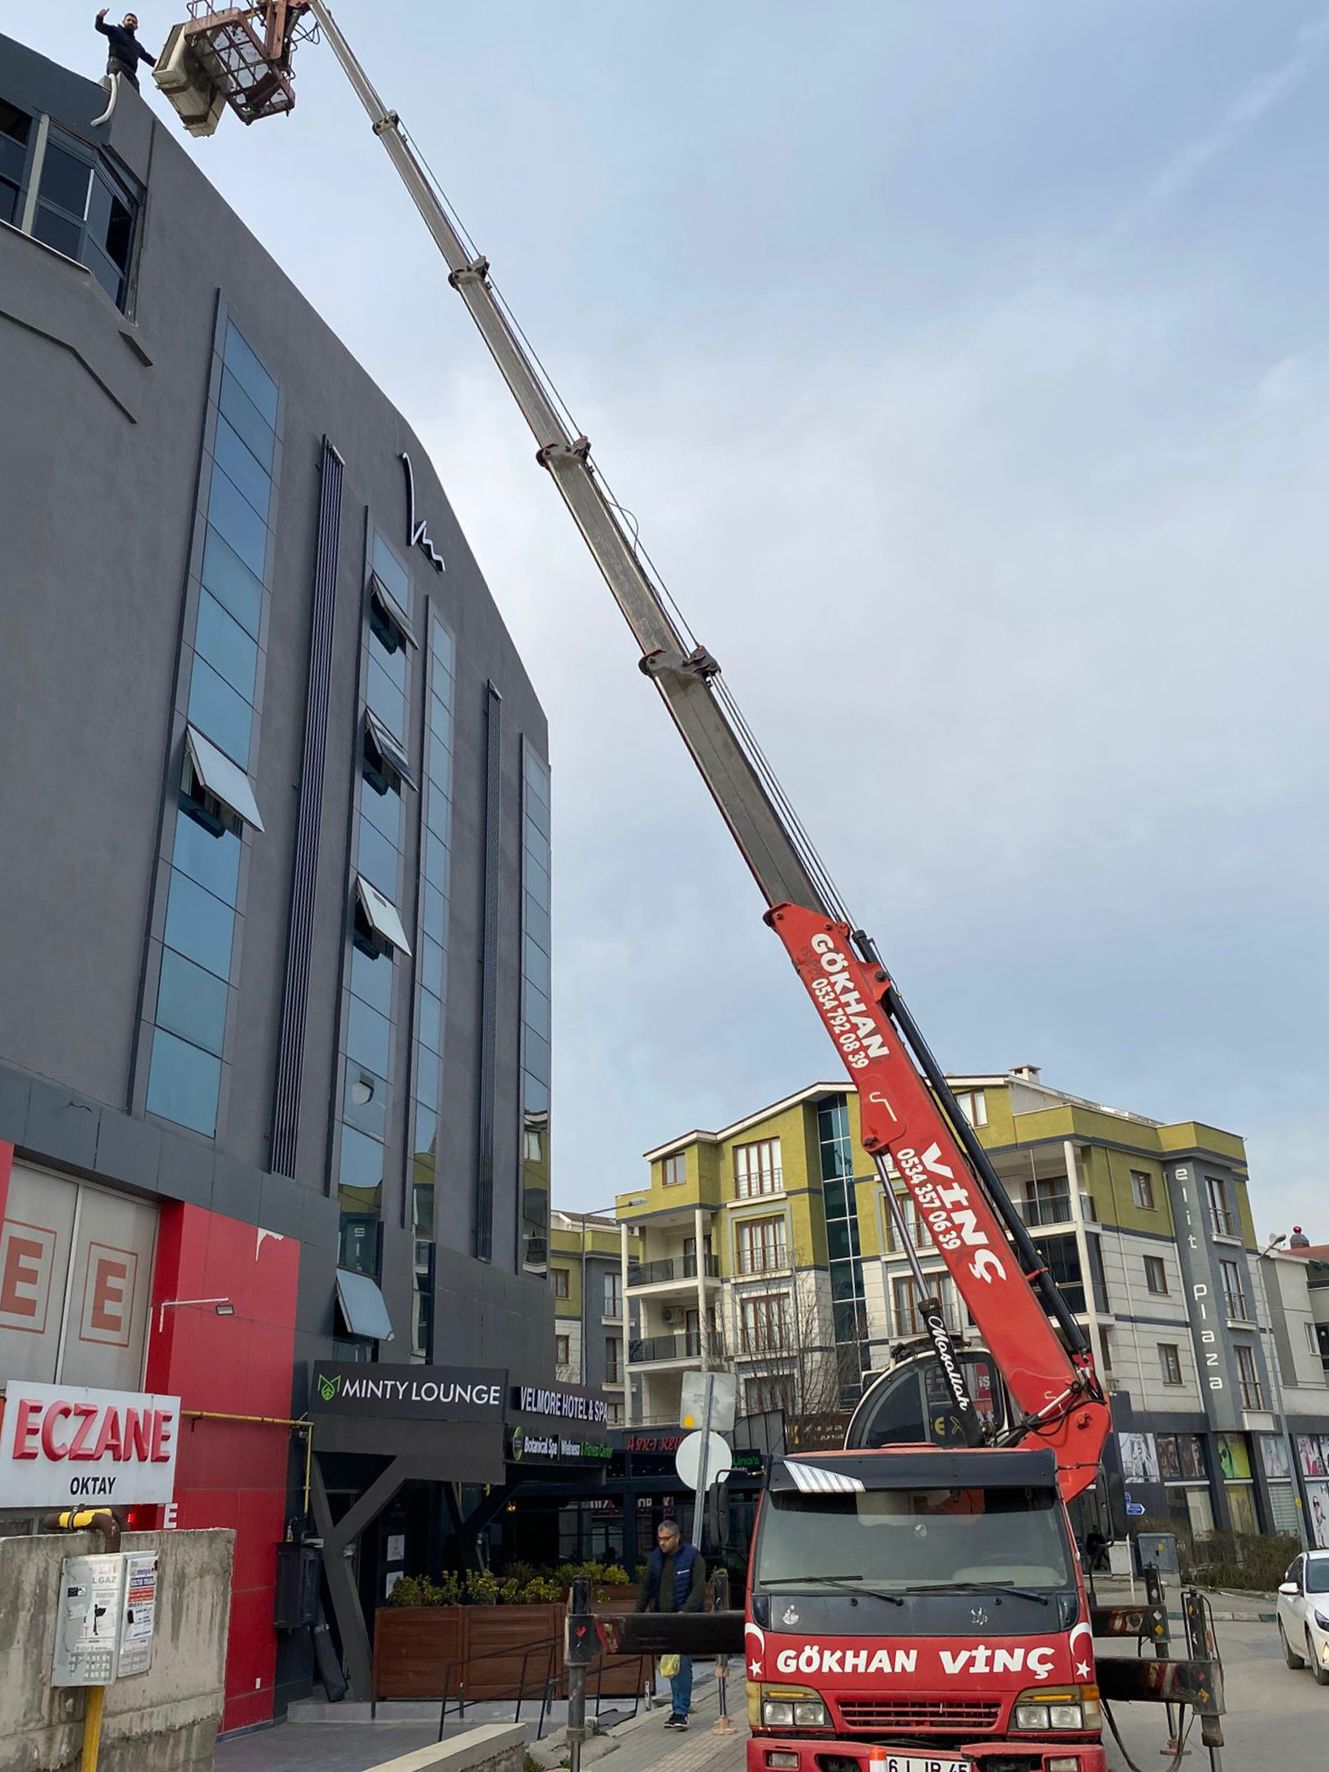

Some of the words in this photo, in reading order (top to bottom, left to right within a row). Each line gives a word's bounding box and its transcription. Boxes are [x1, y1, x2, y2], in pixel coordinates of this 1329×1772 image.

[811, 978, 839, 1010] 0534
[811, 933, 890, 1058] GÖKHAN
[826, 1007, 851, 1034] 792
[839, 1033, 860, 1052] 08
[848, 1051, 870, 1069] 39
[896, 1148, 928, 1185] 0534
[914, 1183, 941, 1208] 357
[920, 1141, 1007, 1284] VİNÇ
[928, 1210, 952, 1232] 06
[938, 1230, 961, 1250] 39
[0, 1236, 43, 1317] E
[91, 1258, 127, 1332] E
[342, 1379, 409, 1399] MINTY
[411, 1382, 501, 1405] LOUNGE
[520, 1386, 561, 1416] VELMORE
[562, 1393, 588, 1420] HOTEL
[594, 1400, 608, 1422] SPA
[12, 1398, 173, 1463] ECZANE
[70, 1476, 116, 1495] OKTAY
[776, 1645, 918, 1673] GÖKHAN
[939, 1644, 1055, 1680] VİNÇ
